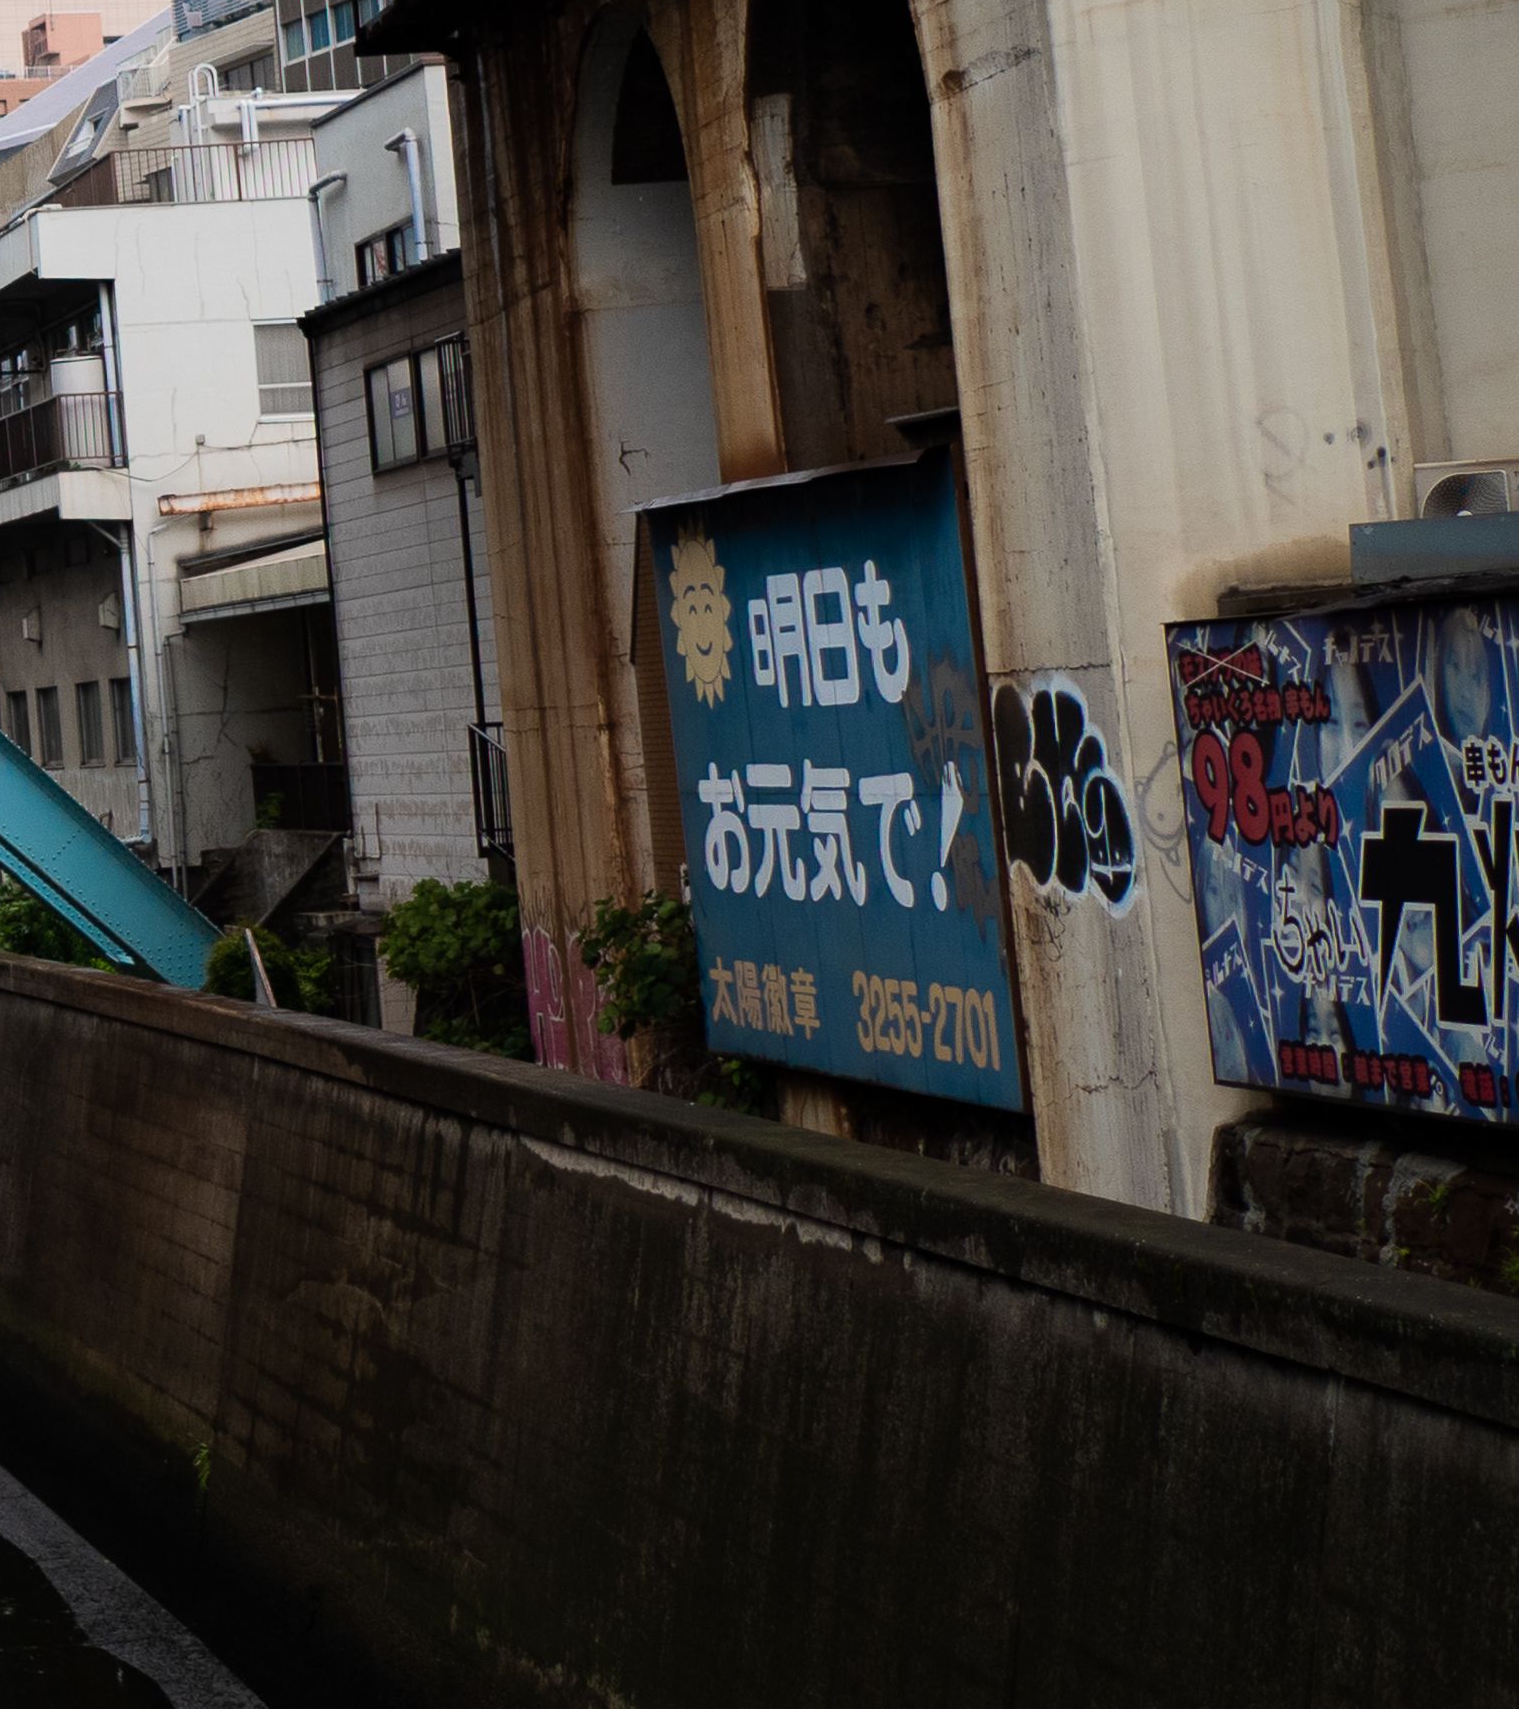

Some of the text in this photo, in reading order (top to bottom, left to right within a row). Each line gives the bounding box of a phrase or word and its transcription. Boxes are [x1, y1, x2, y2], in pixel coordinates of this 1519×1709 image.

[748, 559, 910, 708] 明日も
[709, 956, 821, 1041] 太陽徽章
[852, 970, 1001, 1072] 3255-2701
